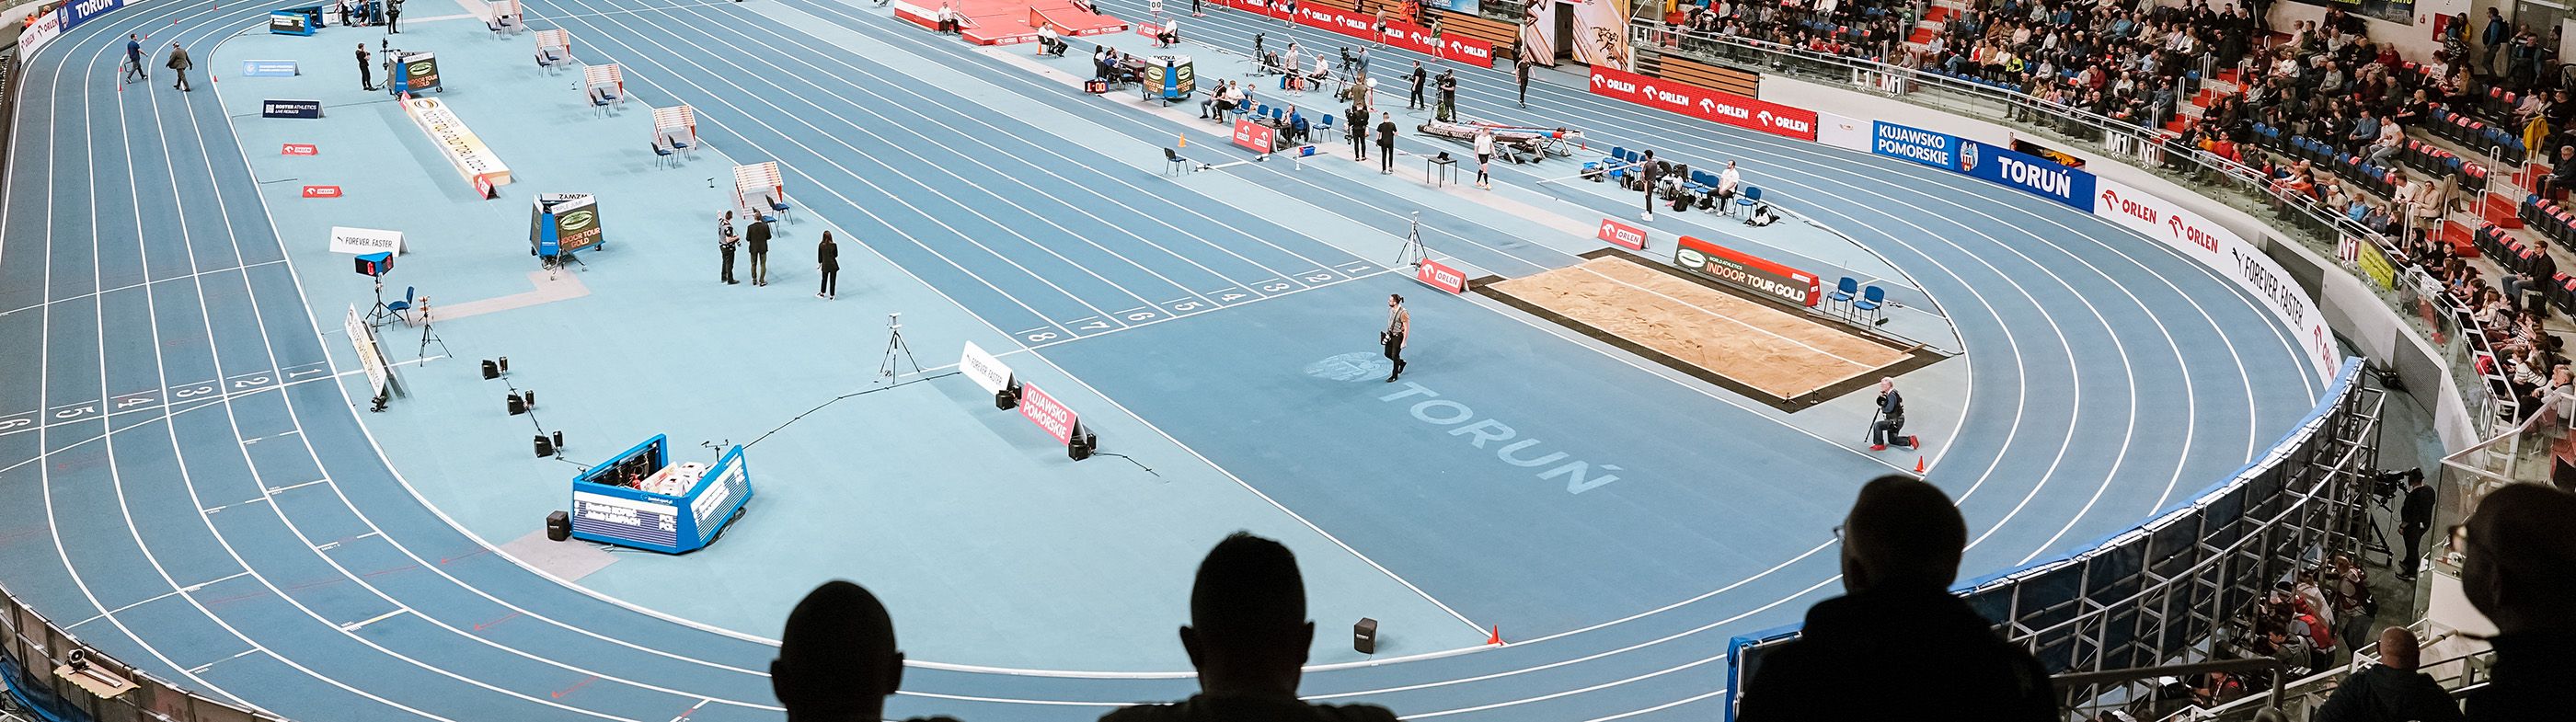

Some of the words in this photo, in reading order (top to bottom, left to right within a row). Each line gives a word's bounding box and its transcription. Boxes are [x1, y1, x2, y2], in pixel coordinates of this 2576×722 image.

[1313, 10, 1332, 22] ORLEN
[43, 18, 59, 32] ORLEN
[1346, 18, 1367, 30] ORLEN
[1464, 47, 1488, 58] ORLEN
[1853, 69, 1870, 87] L1
[1881, 73, 1902, 95] M1
[1607, 79, 1636, 93] ORLEN
[1659, 91, 1689, 106] ORLEN
[1717, 104, 1749, 119] ORLEN
[1775, 117, 1809, 132] ORLEN
[1879, 124, 1945, 149] KUJAWSKO
[2106, 131, 2127, 155] M1
[1878, 141, 1949, 166] POMORSKIE
[2139, 141, 2156, 166] N1
[1997, 155, 2070, 199] TORUŃ
[2122, 199, 2157, 225] ORLEN
[582, 227, 601, 237] TOUR
[1617, 231, 1639, 243] ORLEN
[345, 236, 371, 246] FOREVER.
[372, 238, 394, 249] FASTER.
[570, 237, 590, 248] GOLD
[2186, 226, 2219, 255] ORLEN
[2339, 234, 2356, 264] N1
[1345, 264, 1372, 273] 1
[1709, 257, 1722, 265] WORLD
[1721, 258, 1742, 270] ATHLETICS
[1309, 273, 1332, 284] 2
[1436, 271, 1459, 286] ORLEN
[1706, 261, 1746, 283] INDOOR
[1747, 274, 1775, 292] TOUR
[1775, 281, 1806, 303] GOLD
[1264, 282, 1290, 292] 3
[1221, 292, 1247, 303] 4
[2245, 257, 2279, 304] FOREVER.
[2280, 284, 2304, 332] FASTER.
[1175, 301, 1202, 311] 5
[1127, 312, 1156, 322] 6
[1080, 321, 1110, 331] 7
[1029, 331, 1058, 343] 8
[289, 368, 322, 378] 1
[235, 375, 270, 388] 2
[176, 386, 213, 398] 3
[118, 397, 155, 409] 4
[1027, 388, 1067, 424] KUJAWSKO
[55, 406, 95, 418] 5
[1023, 401, 1067, 441] POMORSKIE
[1379, 381, 1624, 495] TORUŃ
